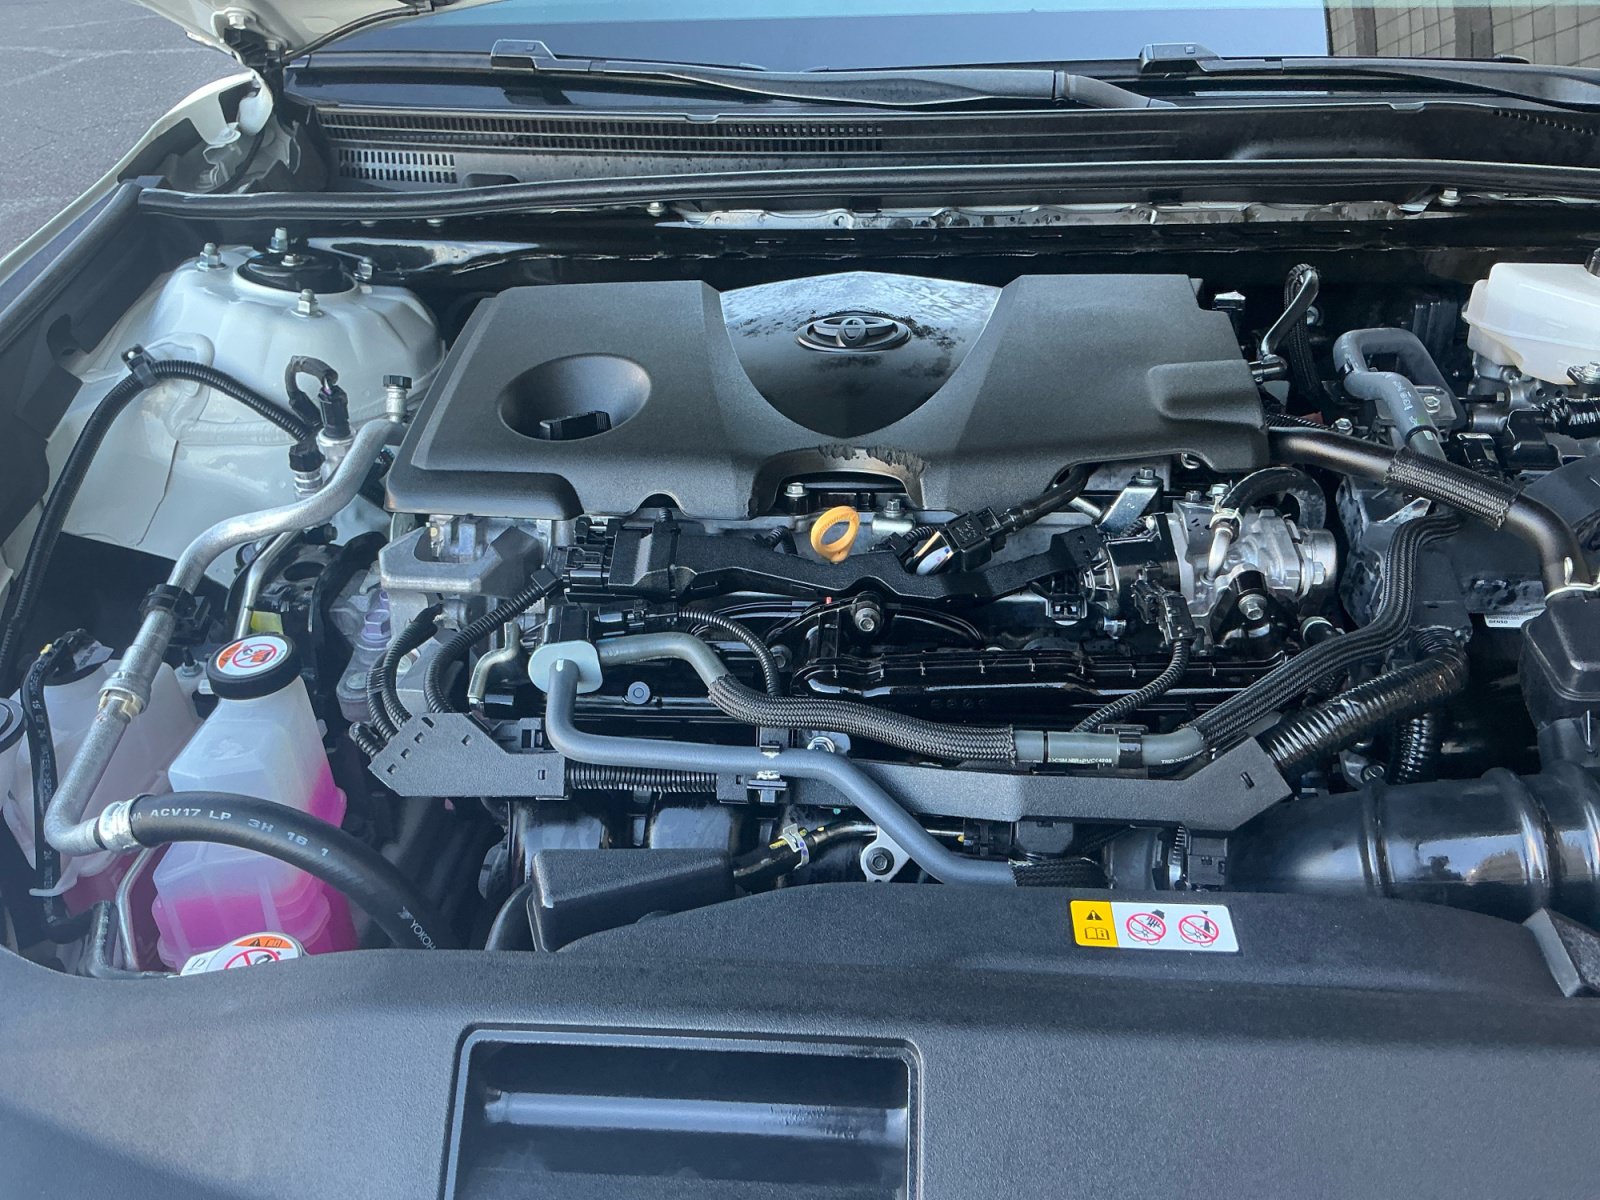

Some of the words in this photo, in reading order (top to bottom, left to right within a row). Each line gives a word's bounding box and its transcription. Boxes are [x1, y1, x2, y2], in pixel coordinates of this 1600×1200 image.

[150, 808, 201, 817] ACV17
[208, 809, 232, 821] LP
[248, 818, 275, 833] 3H
